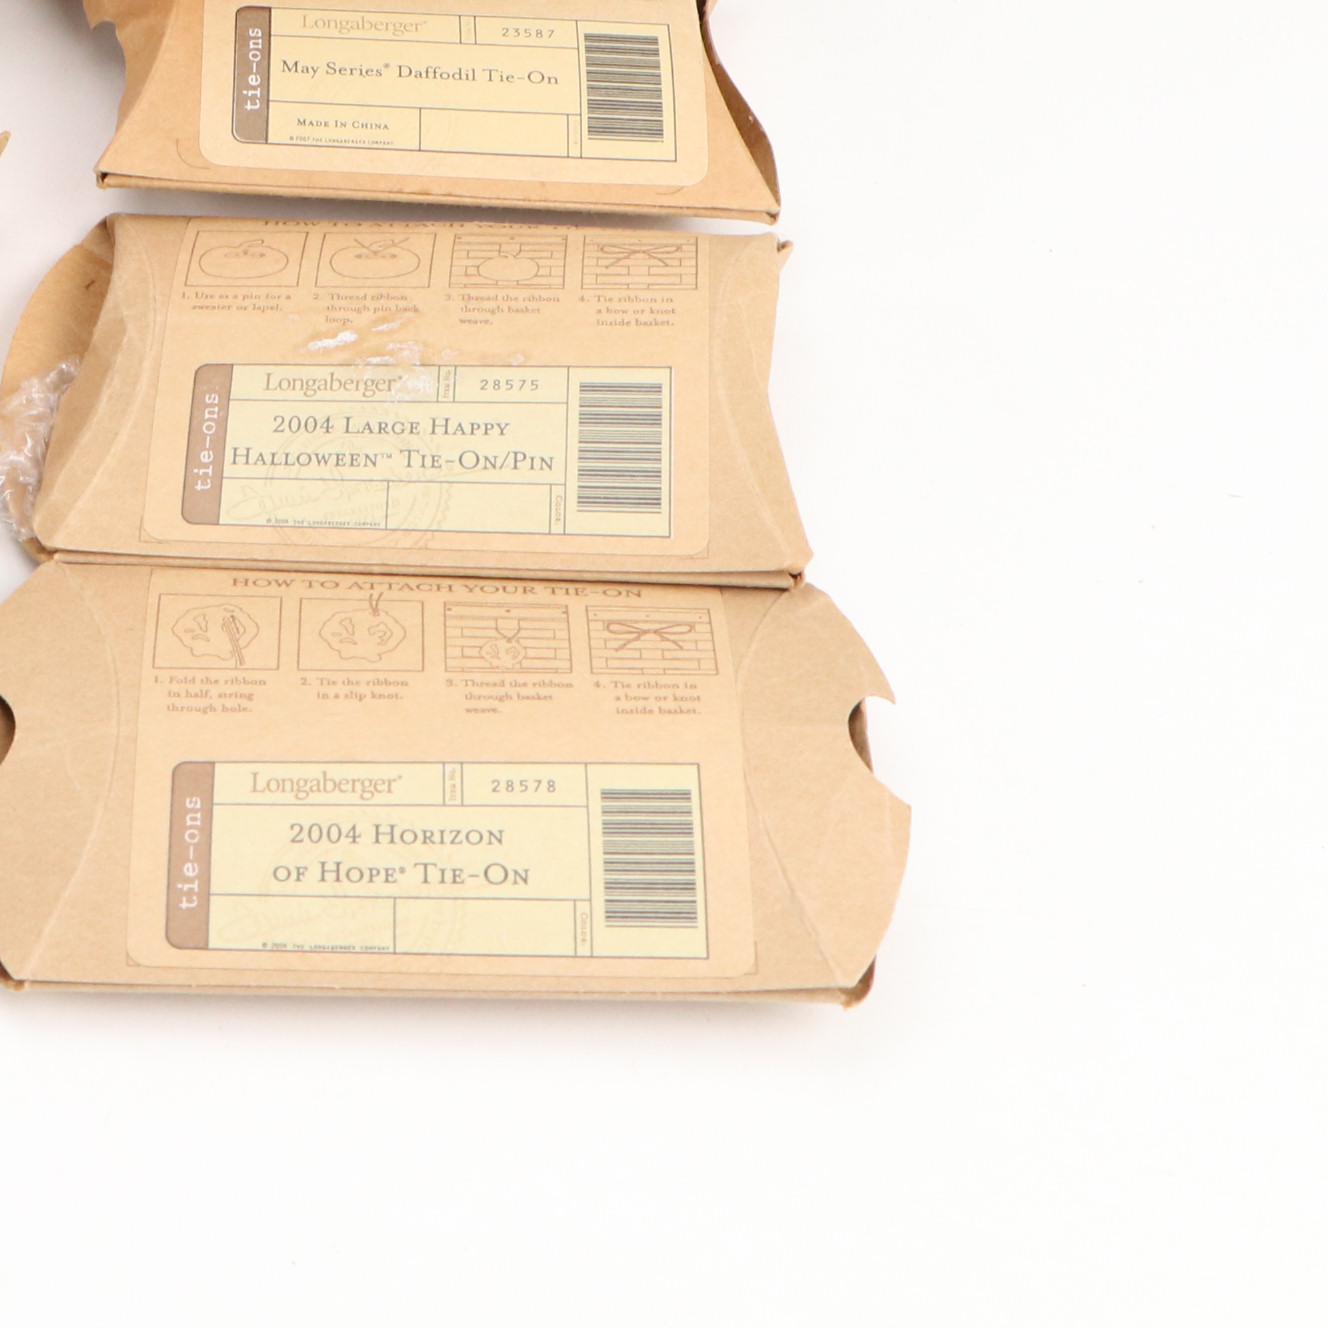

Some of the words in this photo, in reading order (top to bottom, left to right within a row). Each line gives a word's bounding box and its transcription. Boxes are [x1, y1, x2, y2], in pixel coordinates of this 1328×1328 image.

[501, 26, 556, 40] 23587
[243, 26, 264, 112] tie-ons
[281, 59, 320, 79] May
[397, 63, 477, 82] Daffodil
[481, 67, 559, 87] Tie-On
[480, 378, 540, 391] 28575
[272, 415, 335, 434] 2004
[343, 416, 420, 435] LARGE
[429, 417, 511, 437] HAPPY
[194, 390, 220, 491] tie-ons
[230, 576, 297, 589] HOW
[303, 578, 341, 590] TO
[347, 580, 454, 593] ATTACH
[461, 583, 536, 596] YOUR
[490, 778, 557, 794] 28578
[289, 822, 362, 844] 2004
[372, 822, 504, 847] HORIZON
[177, 794, 202, 910] tie-ons
[413, 862, 531, 886] TIE-ON
